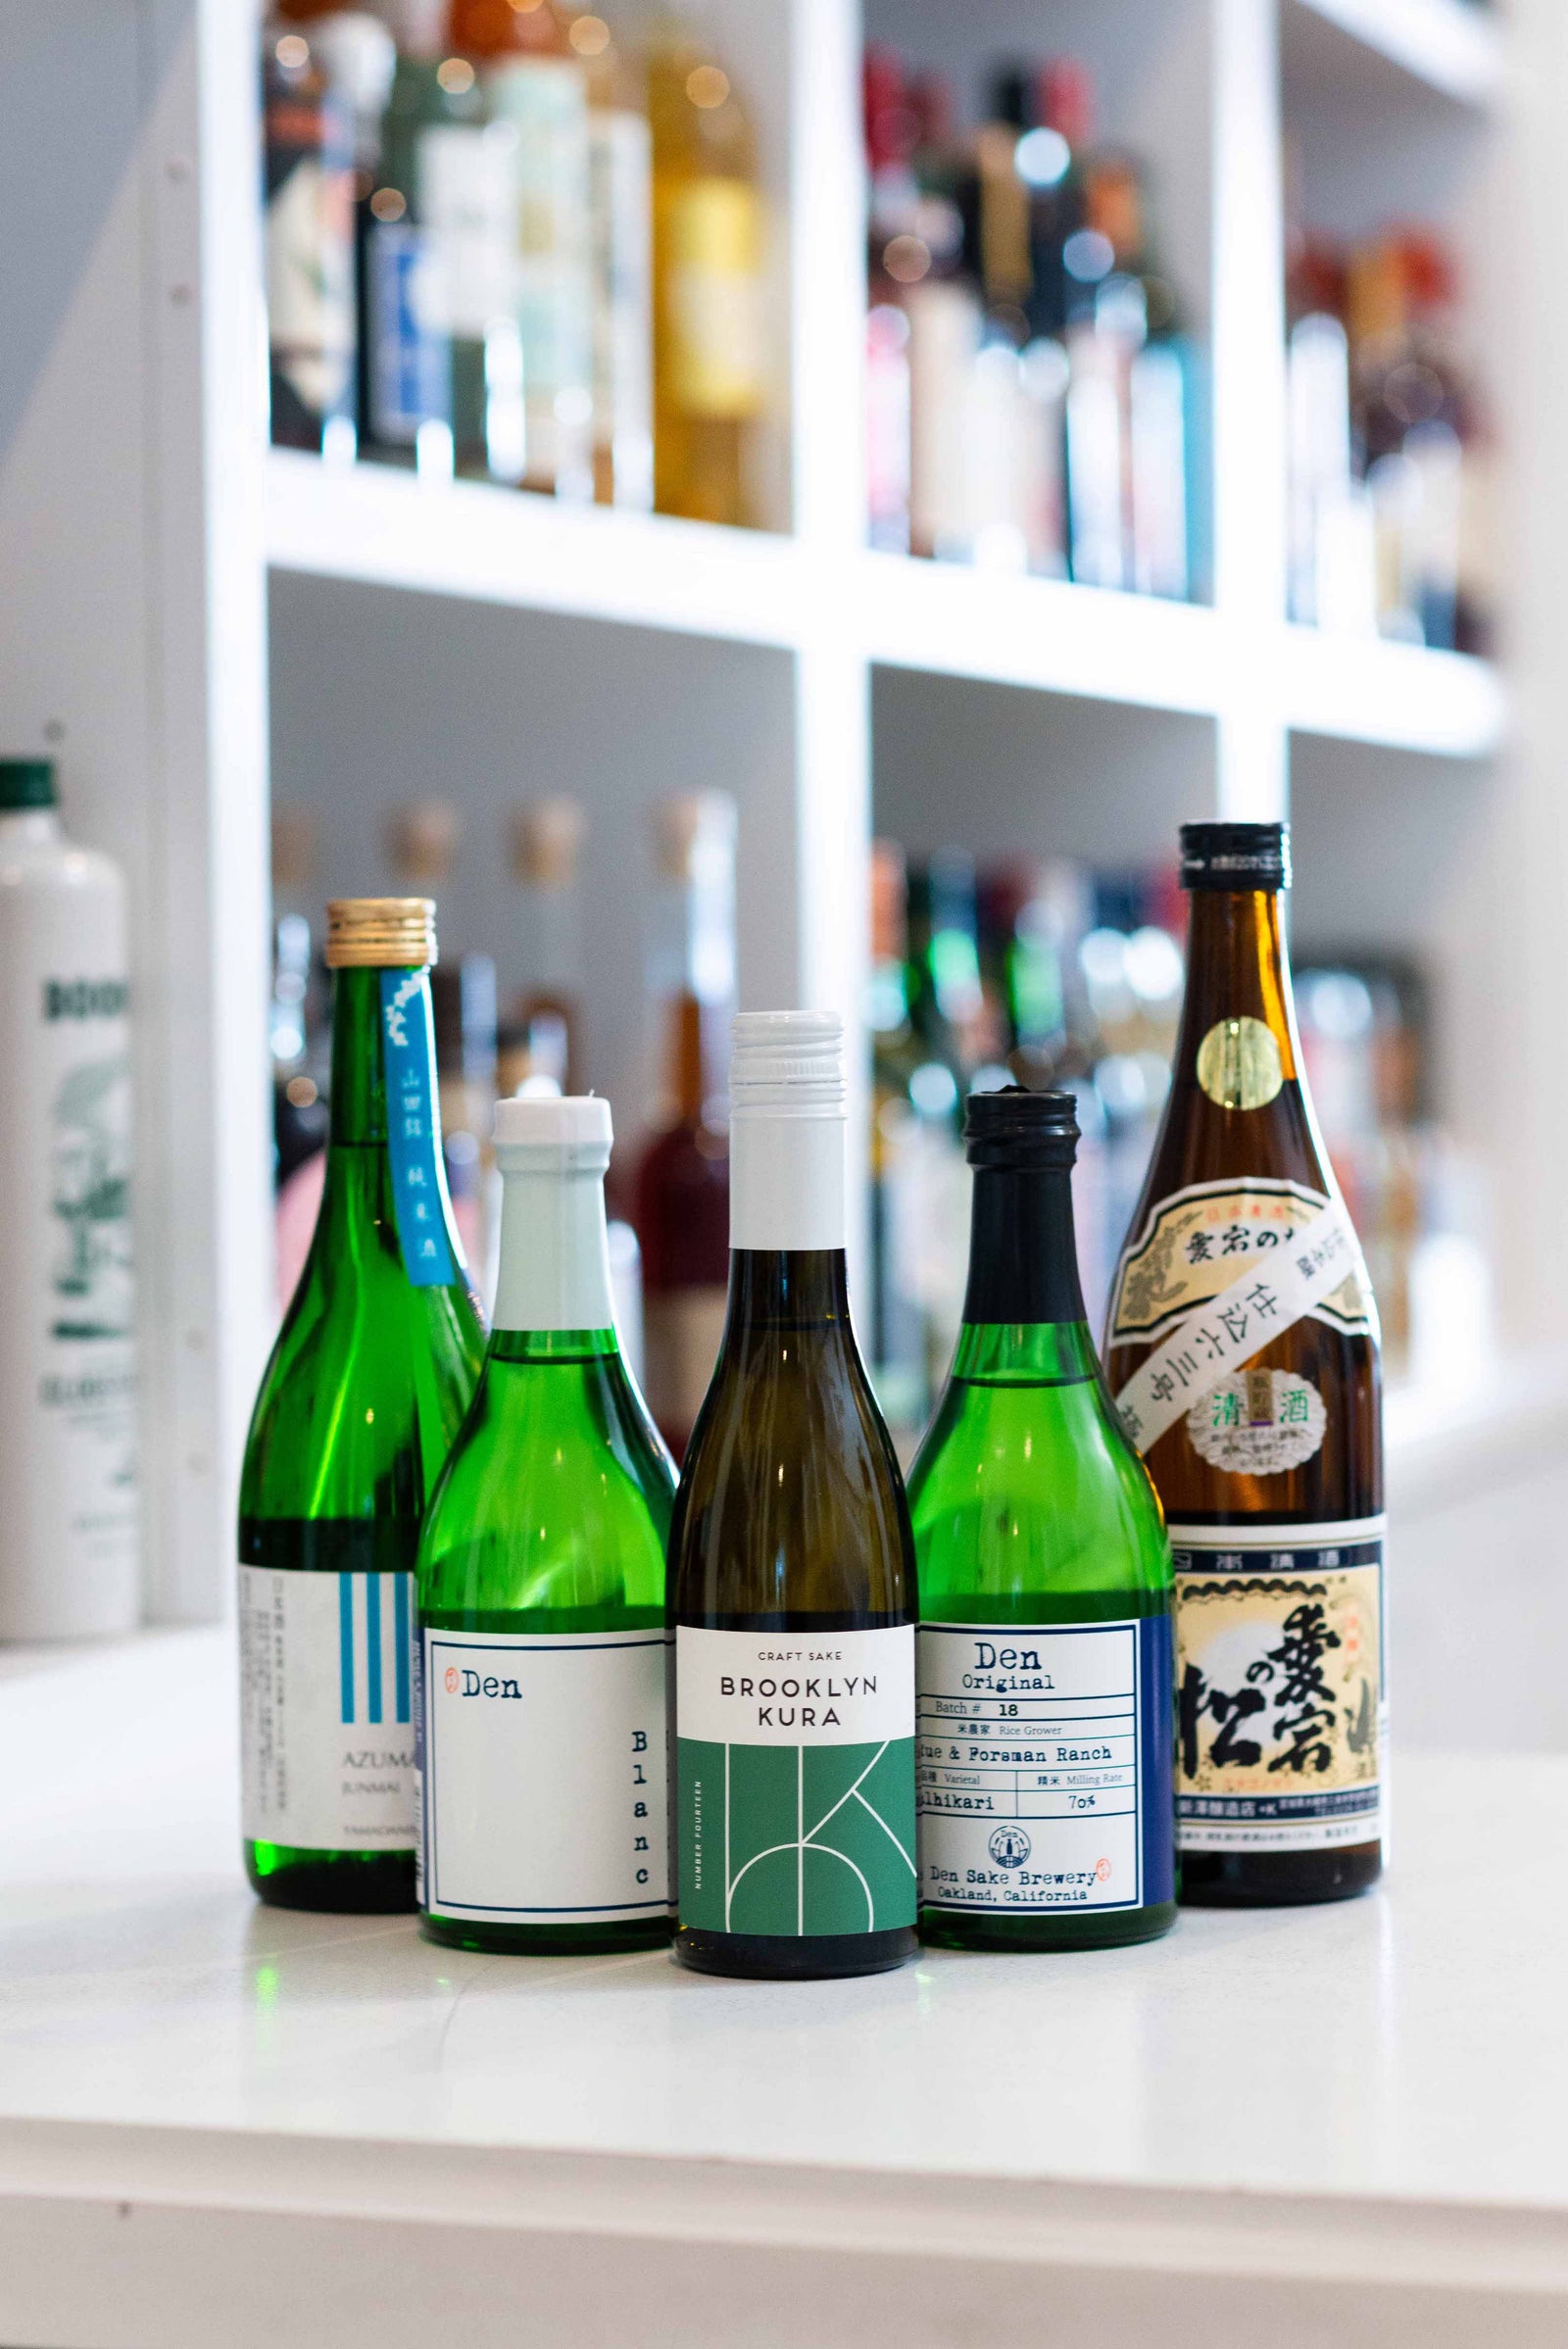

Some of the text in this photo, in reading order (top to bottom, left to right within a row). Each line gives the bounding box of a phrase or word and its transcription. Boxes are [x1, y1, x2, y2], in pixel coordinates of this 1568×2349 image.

[758, 1651, 842, 1661] CRAFT SAKE
[974, 1641, 1043, 1670] Den
[461, 1669, 523, 1699] Den
[720, 1676, 877, 1697] BROOKLYN
[961, 1674, 1055, 1693] Original
[759, 1707, 841, 1726] KURA
[936, 1701, 1018, 1716] Batch # 18
[999, 1725, 1062, 1736] Rice Grower
[949, 1745, 960, 1760] &
[1056, 1745, 1112, 1761] Ranch
[944, 1774, 980, 1785] Varietal
[1066, 1773, 1123, 1786] Milling Rate
[631, 1731, 650, 1884] Blanc
[1067, 1795, 1096, 1809] 70%
[1001, 1830, 1018, 1838] Den
[930, 1866, 958, 1883] Den
[966, 1870, 1009, 1885] Sake
[1018, 1870, 1097, 1886] Brewery
[937, 1886, 1088, 1902] Oakland, California
